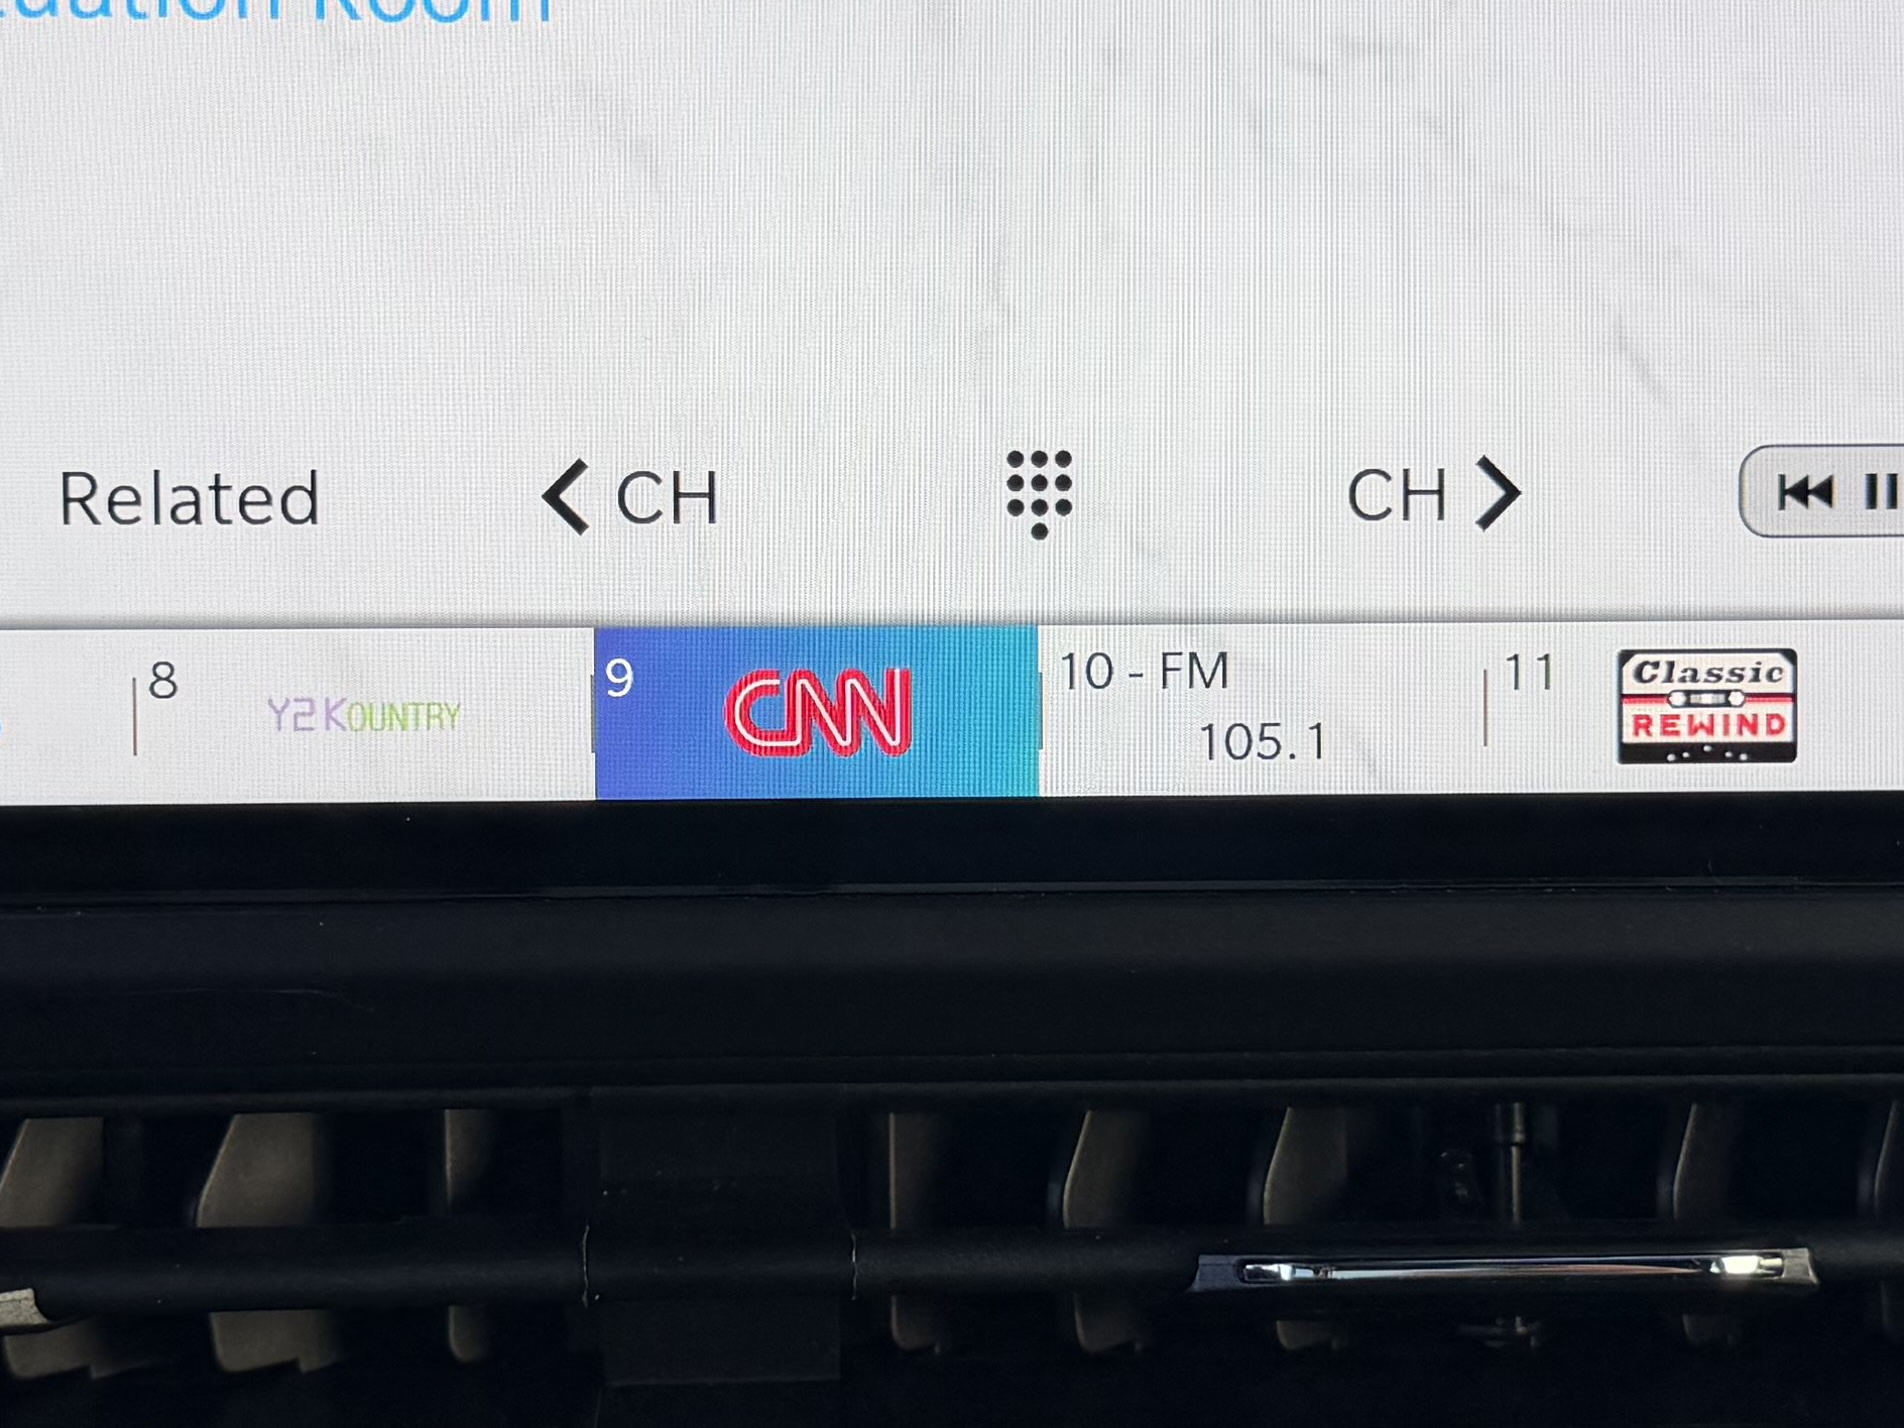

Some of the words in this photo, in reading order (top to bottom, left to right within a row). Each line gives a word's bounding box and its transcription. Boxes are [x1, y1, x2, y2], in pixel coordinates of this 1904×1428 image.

[61, 469, 320, 525] Related
[617, 470, 717, 525] CH
[1348, 468, 1445, 522] CH
[149, 661, 178, 699] 8
[606, 657, 633, 699] 9
[1061, 652, 1113, 691] 10
[1162, 651, 1229, 690] FM
[1506, 653, 1554, 690] 11
[1632, 653, 1783, 686] Classic
[724, 667, 912, 758] CNN
[1632, 713, 1786, 738] REWIND
[1201, 721, 1326, 762] 105.1
